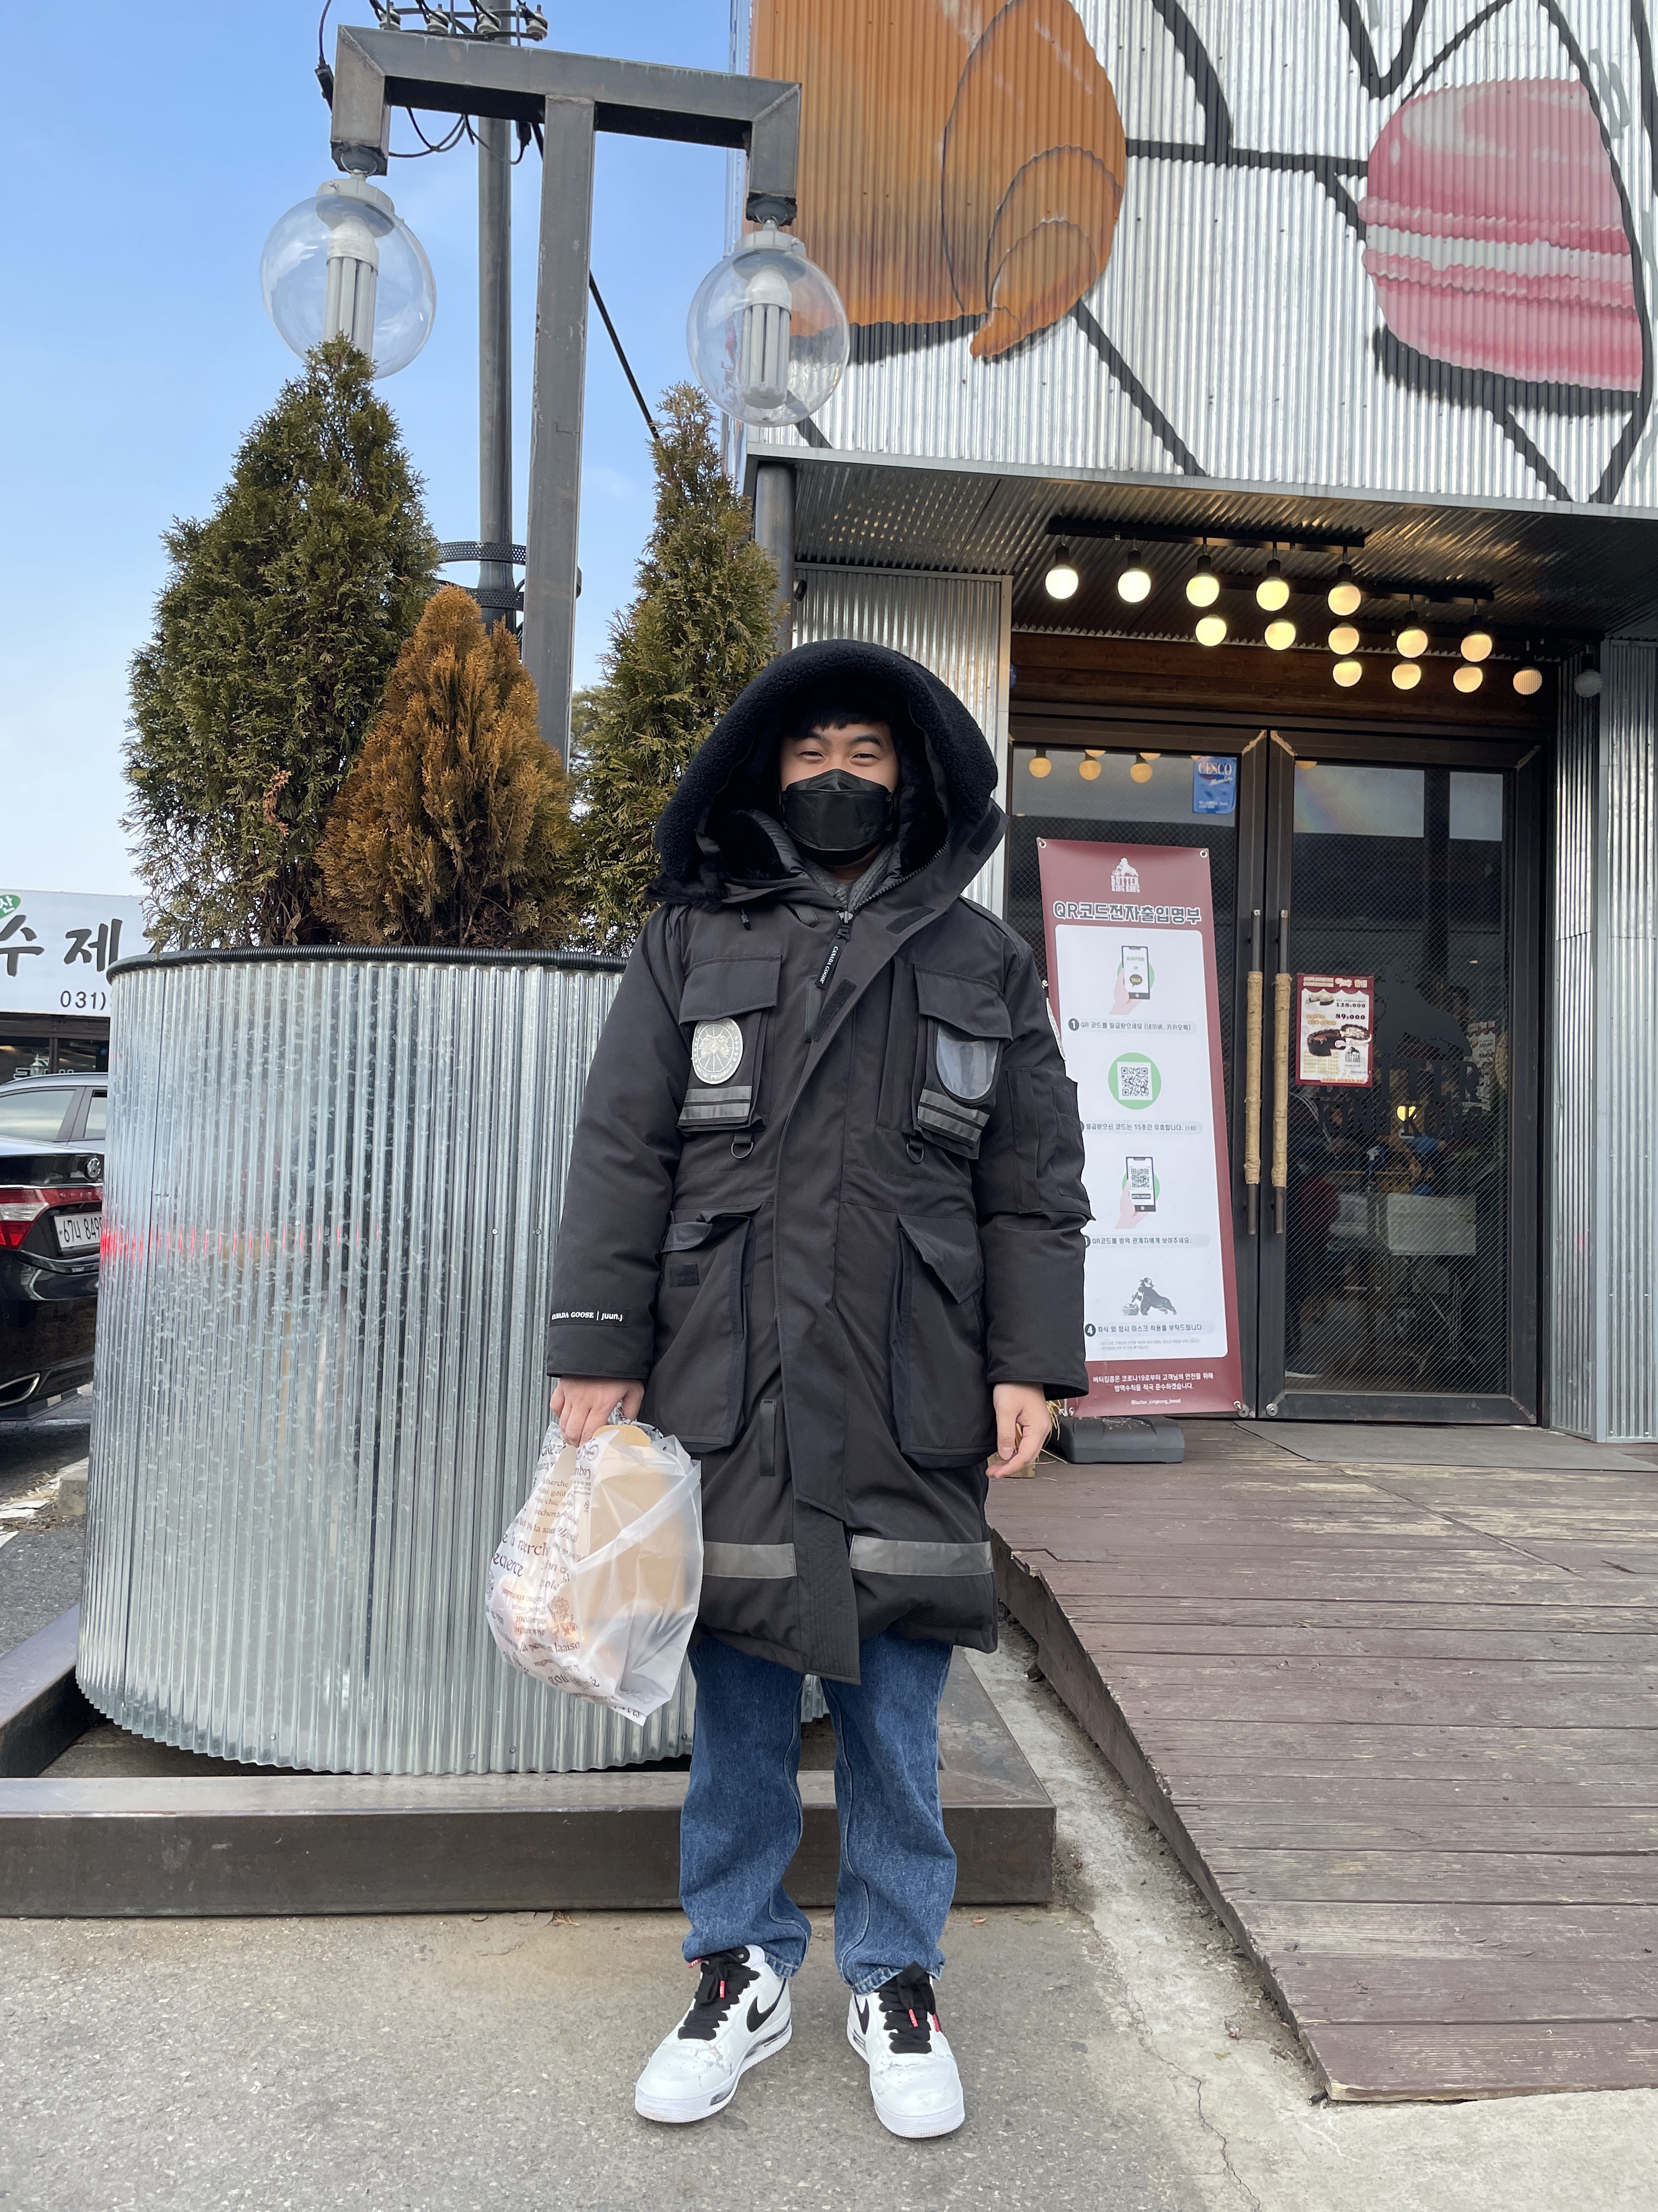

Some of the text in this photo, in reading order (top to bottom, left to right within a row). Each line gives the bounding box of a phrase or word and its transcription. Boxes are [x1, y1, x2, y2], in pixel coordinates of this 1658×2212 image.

[1198, 763, 1232, 775] CESCO
[1110, 876, 1138, 885] BUTTER
[1111, 884, 1125, 892] KING
[1053, 901, 1202, 924] QR코드전자출입명부
[820, 946, 839, 984] CANADA GOOSE
[60, 990, 106, 1010] 031)
[695, 1065, 709, 1078] ARCTIC
[1315, 1101, 1482, 1139] KING KONG
[64, 1220, 81, 1242] 67나
[1092, 1375, 1120, 1384] 버터킹콩은
[1162, 1373, 1184, 1381] 고객님의
[1114, 1384, 1141, 1392] 방역수칙을
